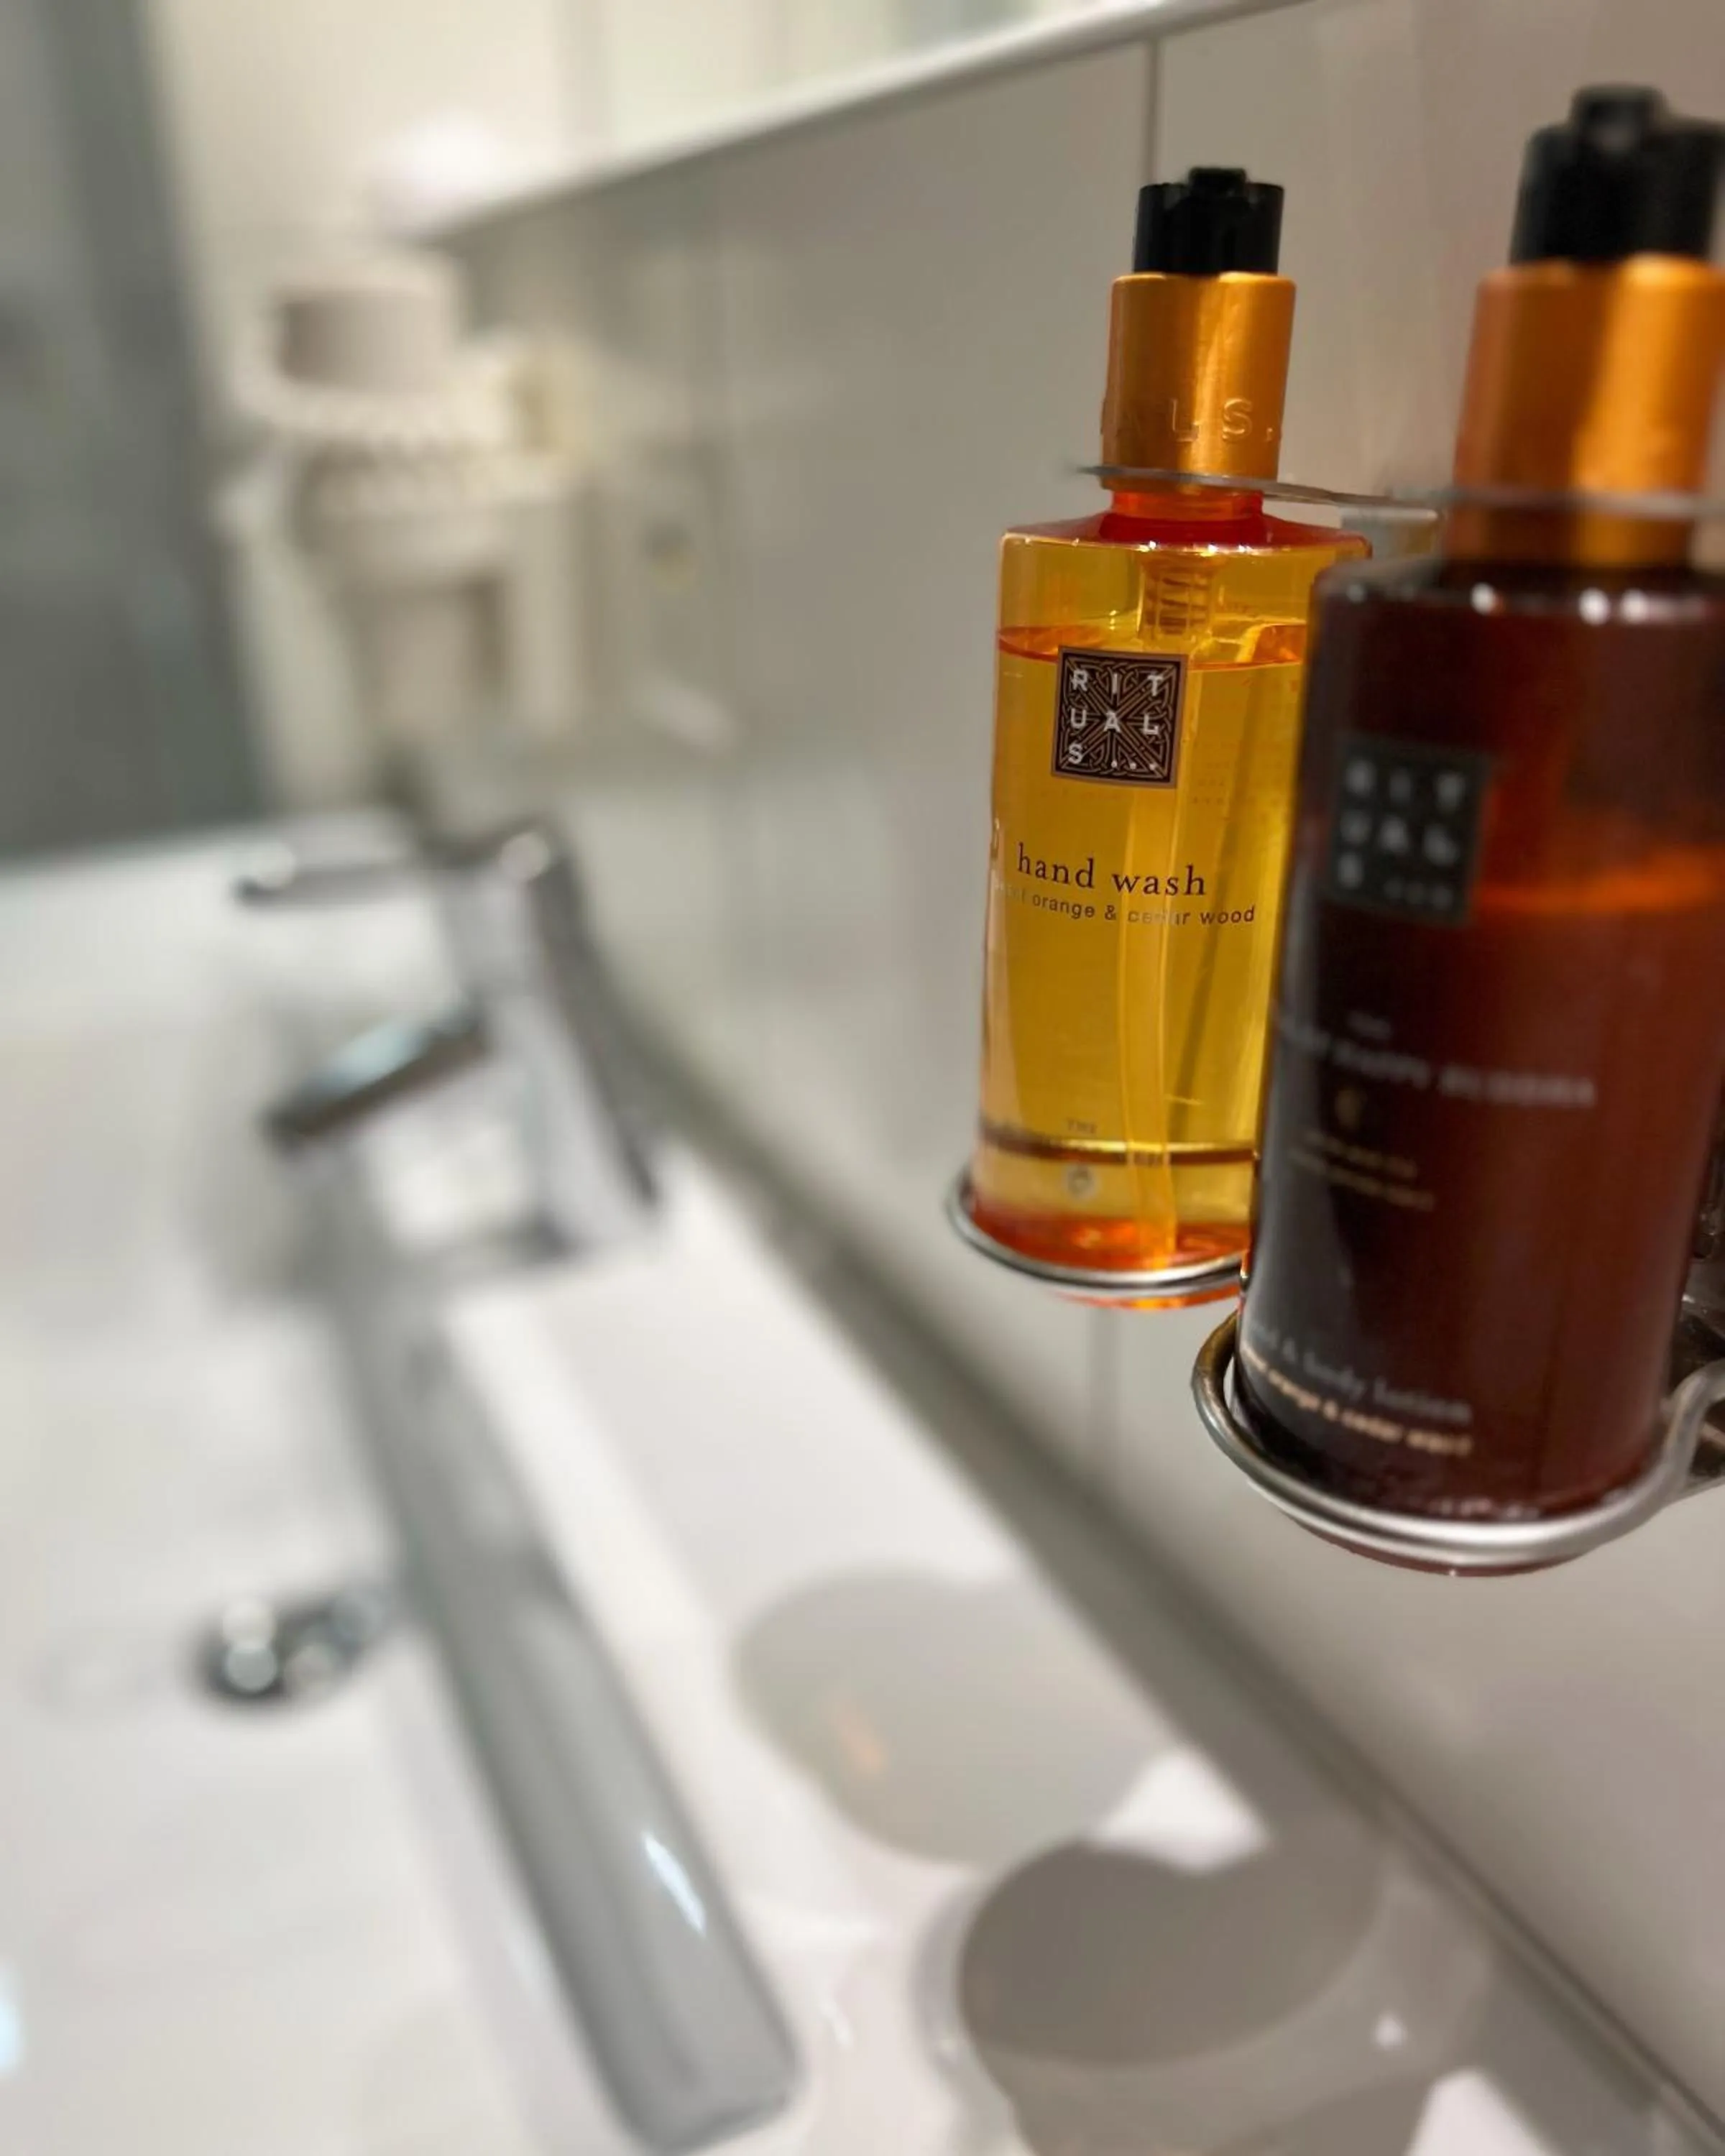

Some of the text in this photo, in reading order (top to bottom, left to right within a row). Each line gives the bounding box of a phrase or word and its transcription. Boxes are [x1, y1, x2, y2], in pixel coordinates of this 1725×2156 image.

[1017, 842, 1207, 895] hand wash
[1032, 893, 1095, 919] orange
[1104, 904, 1117, 921] &
[1200, 903, 1256, 925] wood
